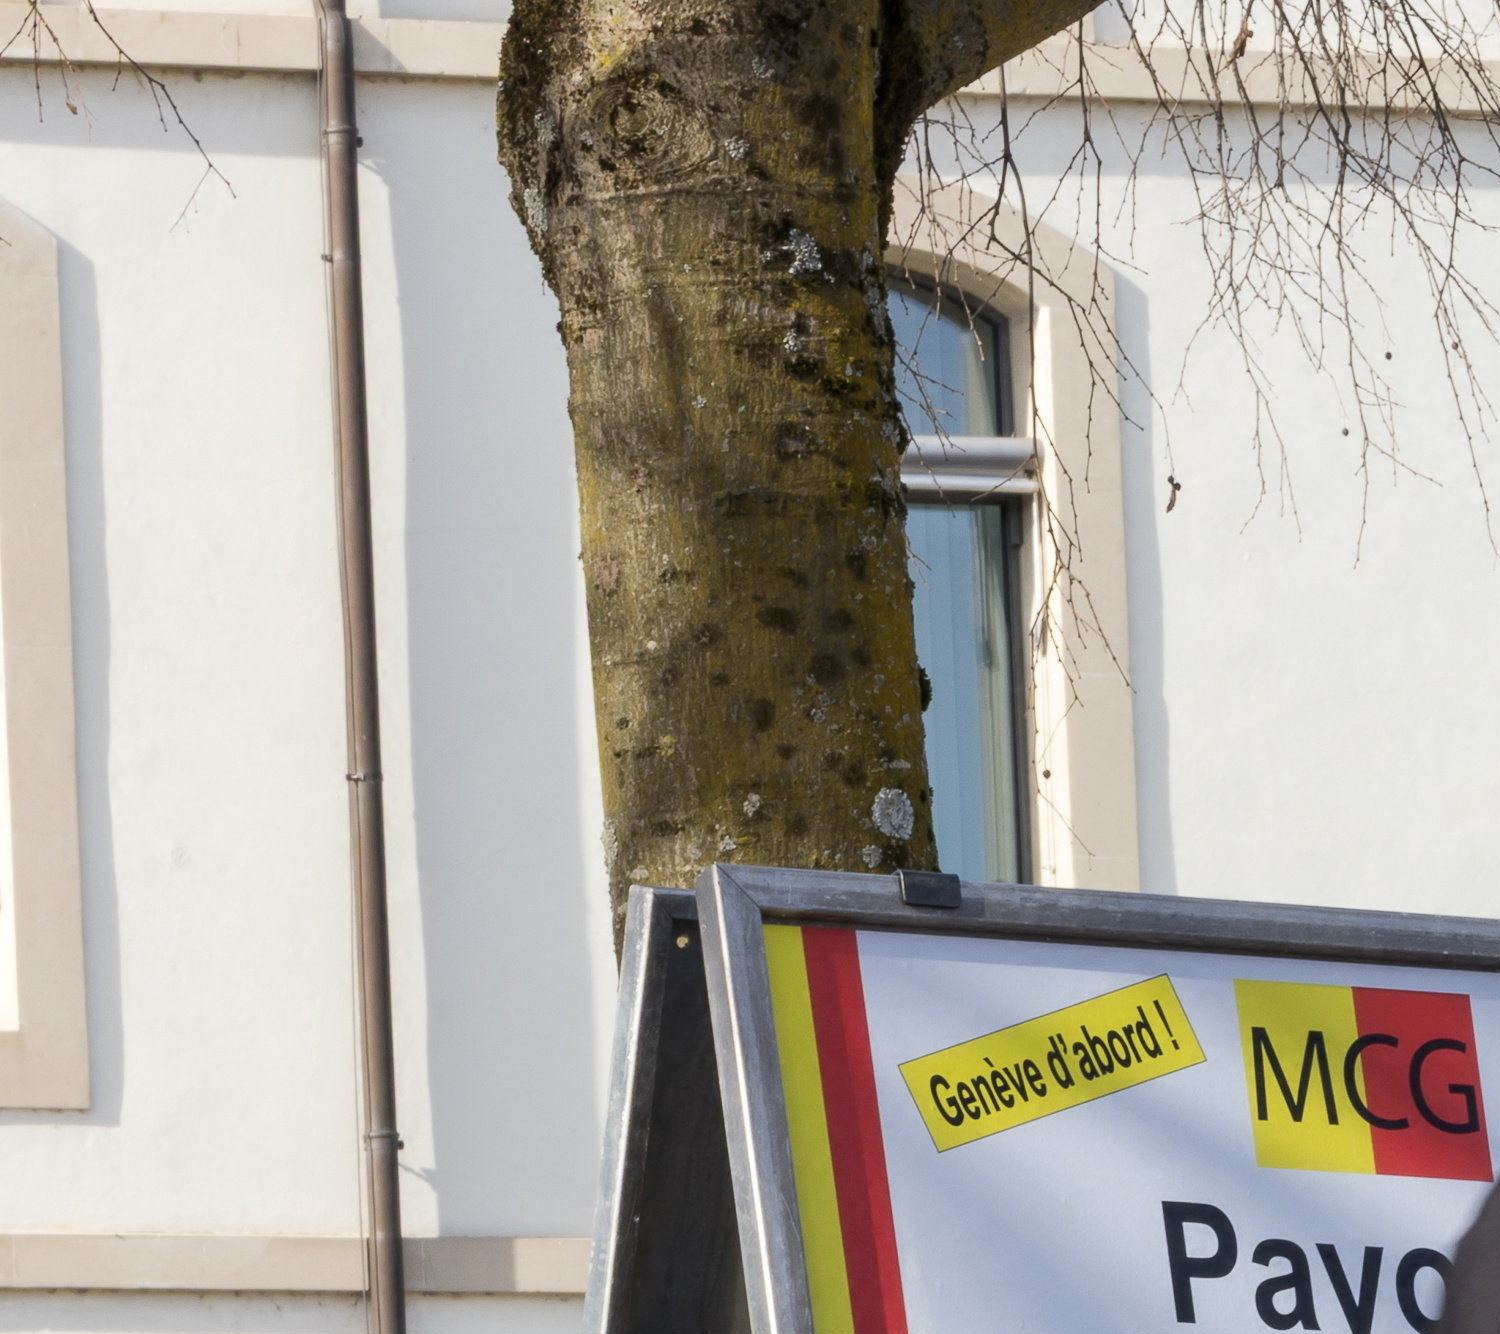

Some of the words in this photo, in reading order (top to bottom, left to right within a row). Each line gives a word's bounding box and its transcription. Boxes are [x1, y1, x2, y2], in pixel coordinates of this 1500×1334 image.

[929, 1061, 1047, 1129] Genève
[1047, 1004, 1159, 1091] d'abord
[1158, 999, 1179, 1052] !
[1250, 1026, 1483, 1135] MCG
